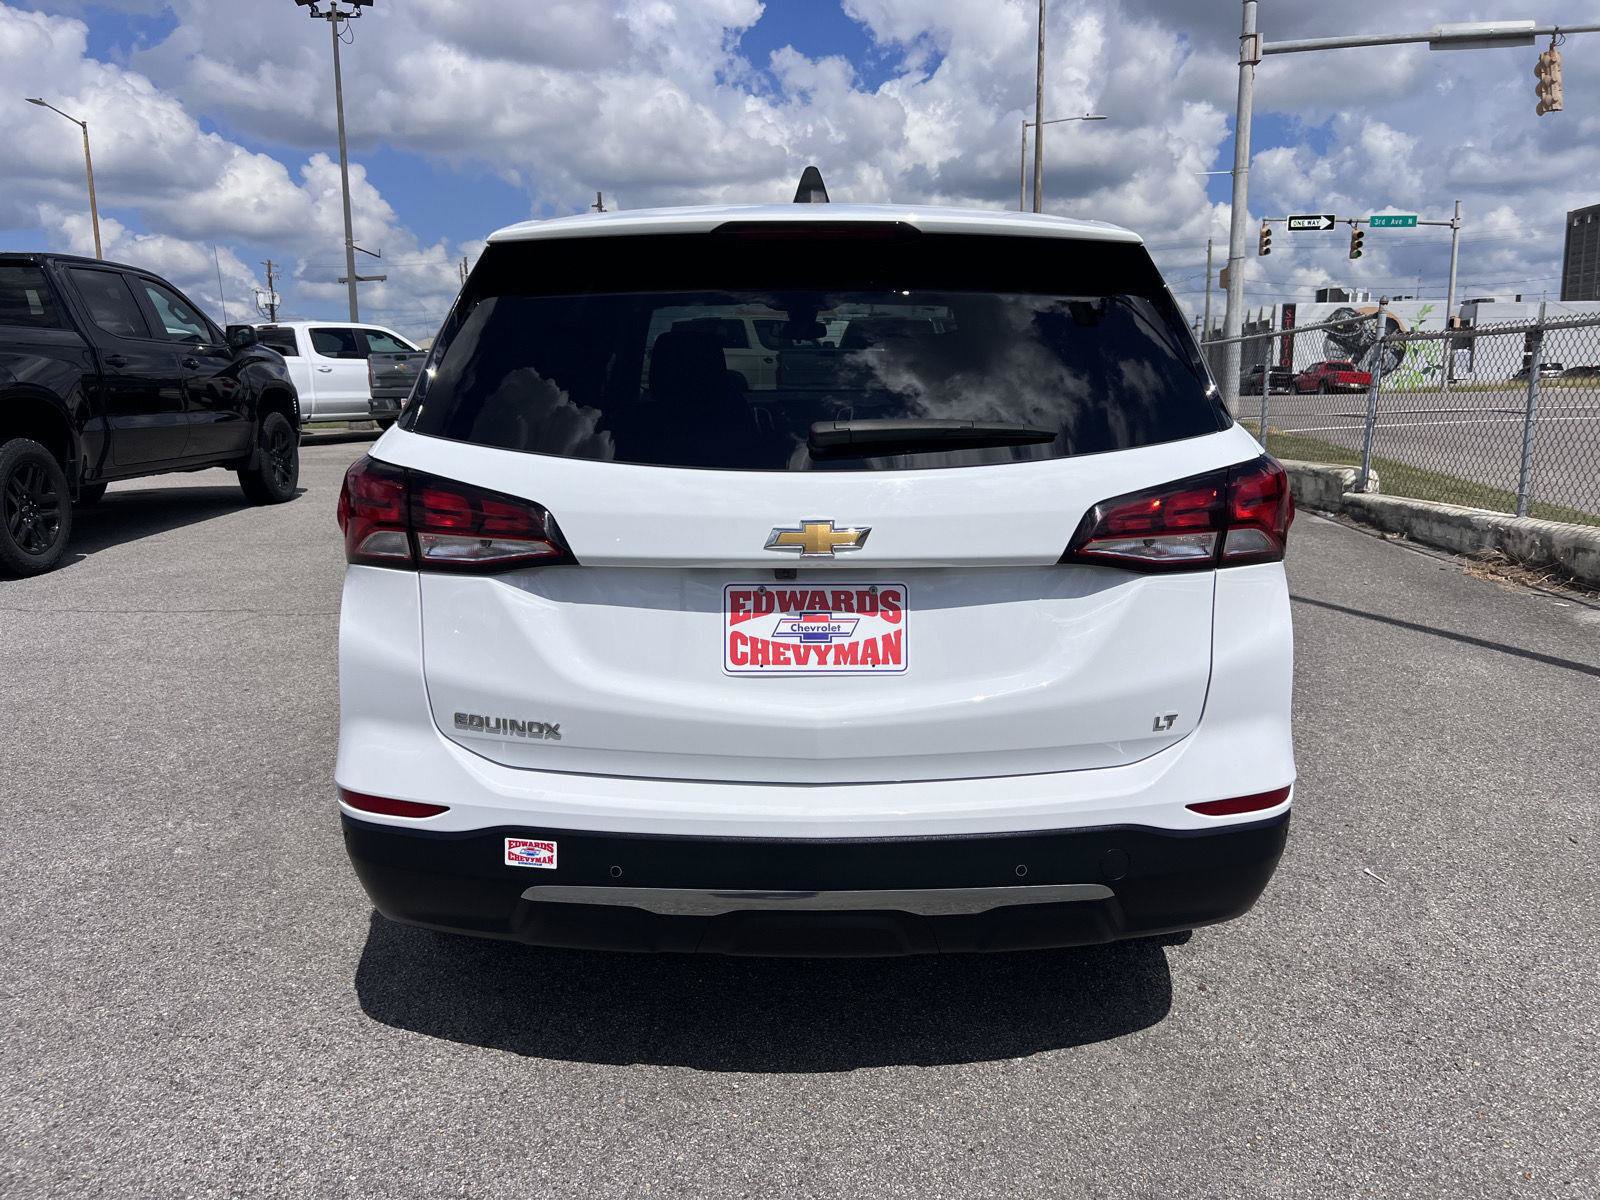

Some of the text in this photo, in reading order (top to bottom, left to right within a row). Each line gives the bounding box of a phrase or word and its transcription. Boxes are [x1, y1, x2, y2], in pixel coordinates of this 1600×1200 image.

[1292, 219, 1303, 227] ONE
[729, 589, 903, 627] EDWARDS
[790, 623, 842, 633] Chevrolet
[729, 629, 903, 666] CHEVYMAN
[454, 712, 562, 740] EQUINOX
[1153, 713, 1178, 732] LT
[507, 839, 554, 853] EDWARDS
[507, 850, 554, 865] CHEVYMAN
